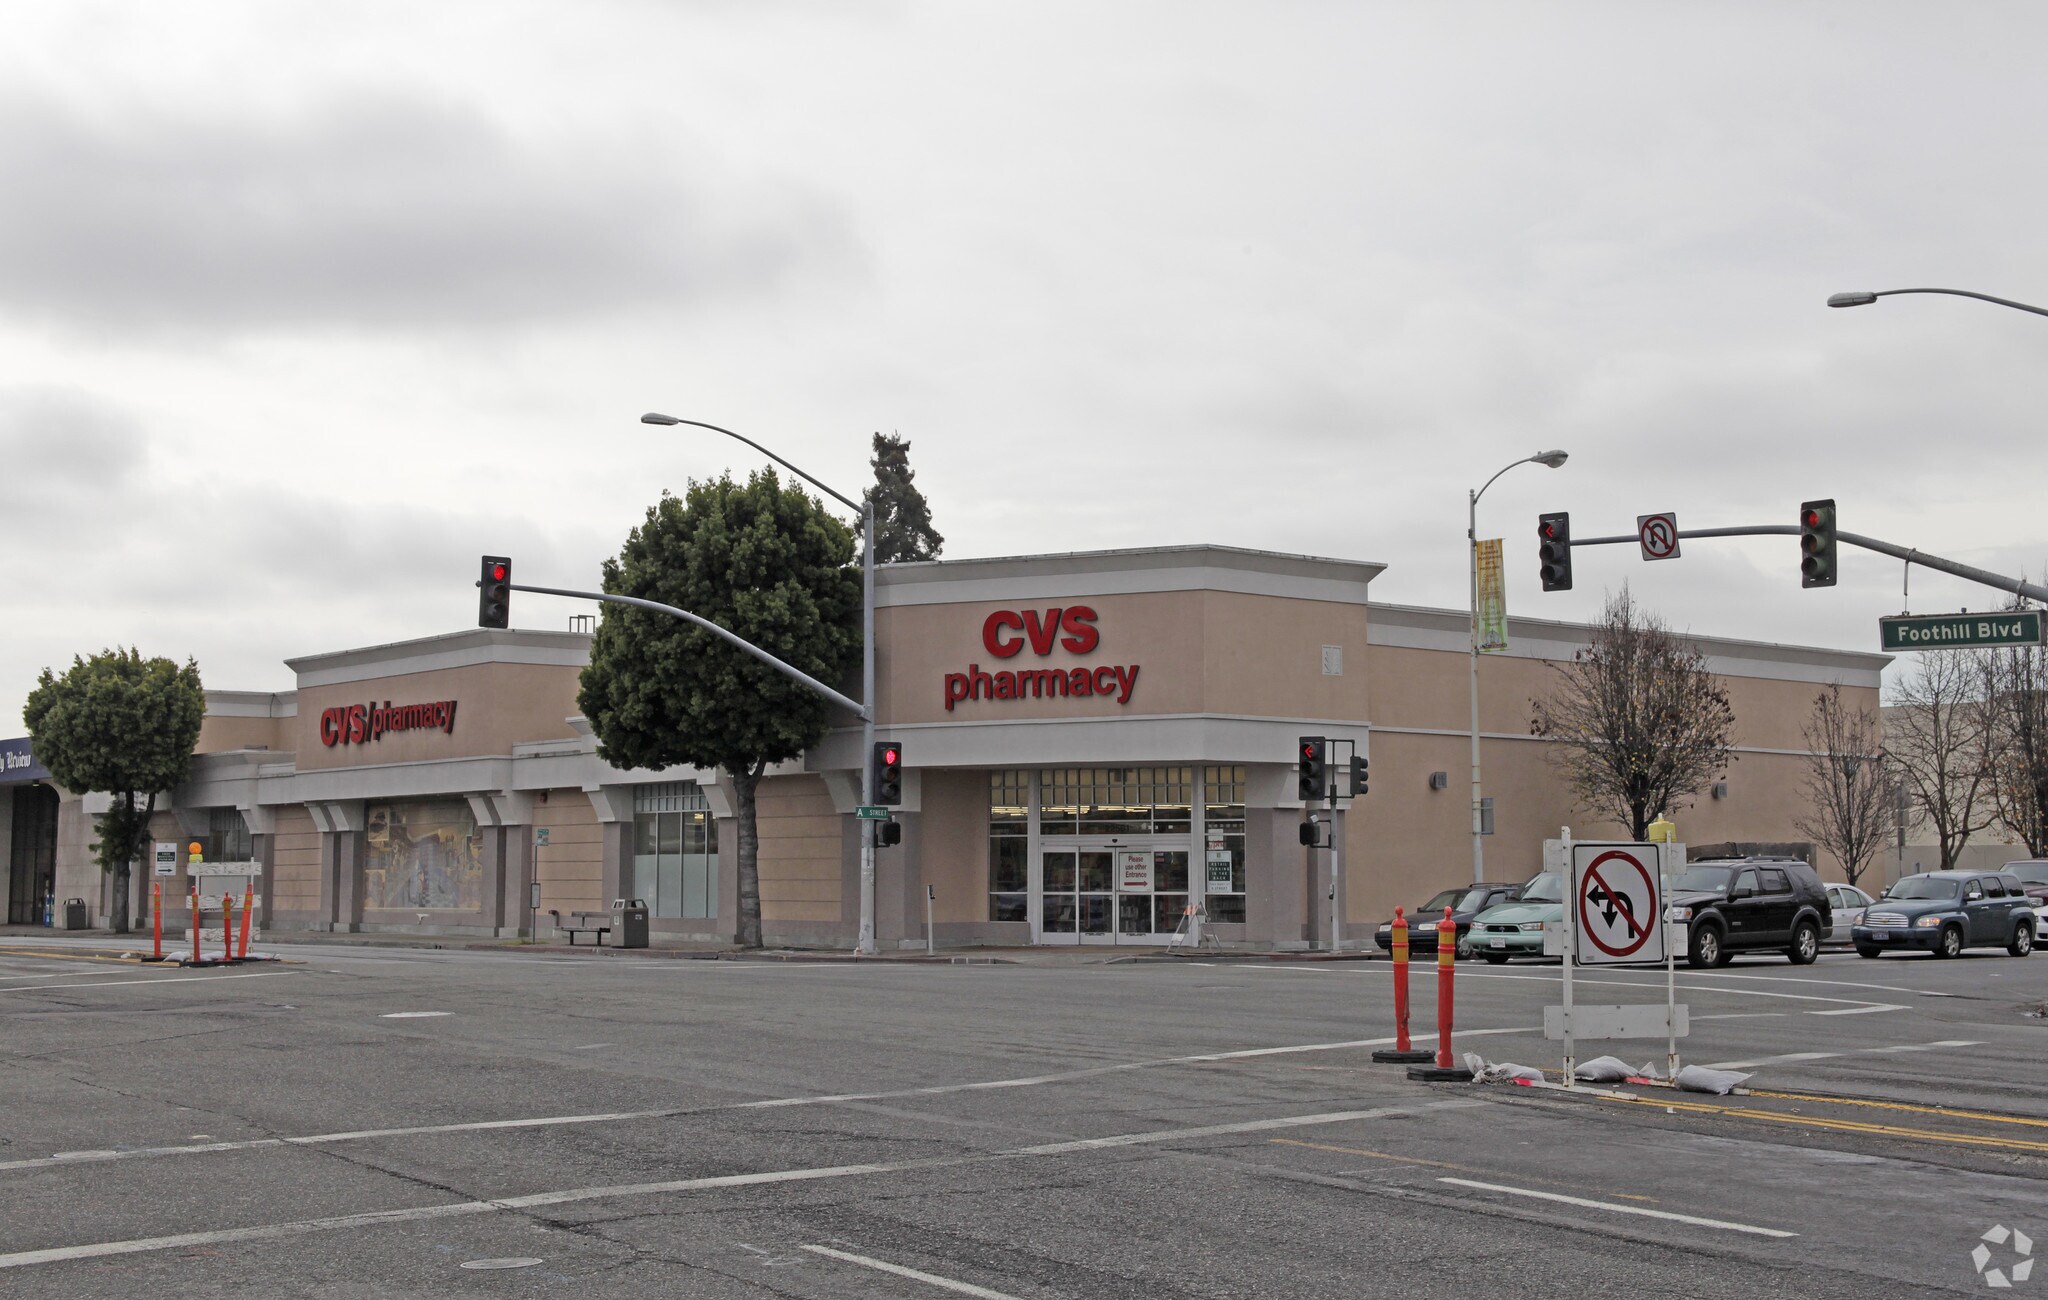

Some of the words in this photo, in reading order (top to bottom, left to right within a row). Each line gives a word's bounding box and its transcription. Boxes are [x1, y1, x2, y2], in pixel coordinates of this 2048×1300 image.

[982, 606, 1100, 658] CVS
[1897, 623, 1971, 641] Foothill
[1977, 621, 2023, 639] Blvd
[944, 664, 1140, 711] pharmacy
[320, 700, 458, 747] CVS/pharmacy
[6, 750, 31, 769] Review
[857, 808, 864, 817] A
[869, 809, 888, 817] STREET
[1128, 855, 1144, 863] Please
